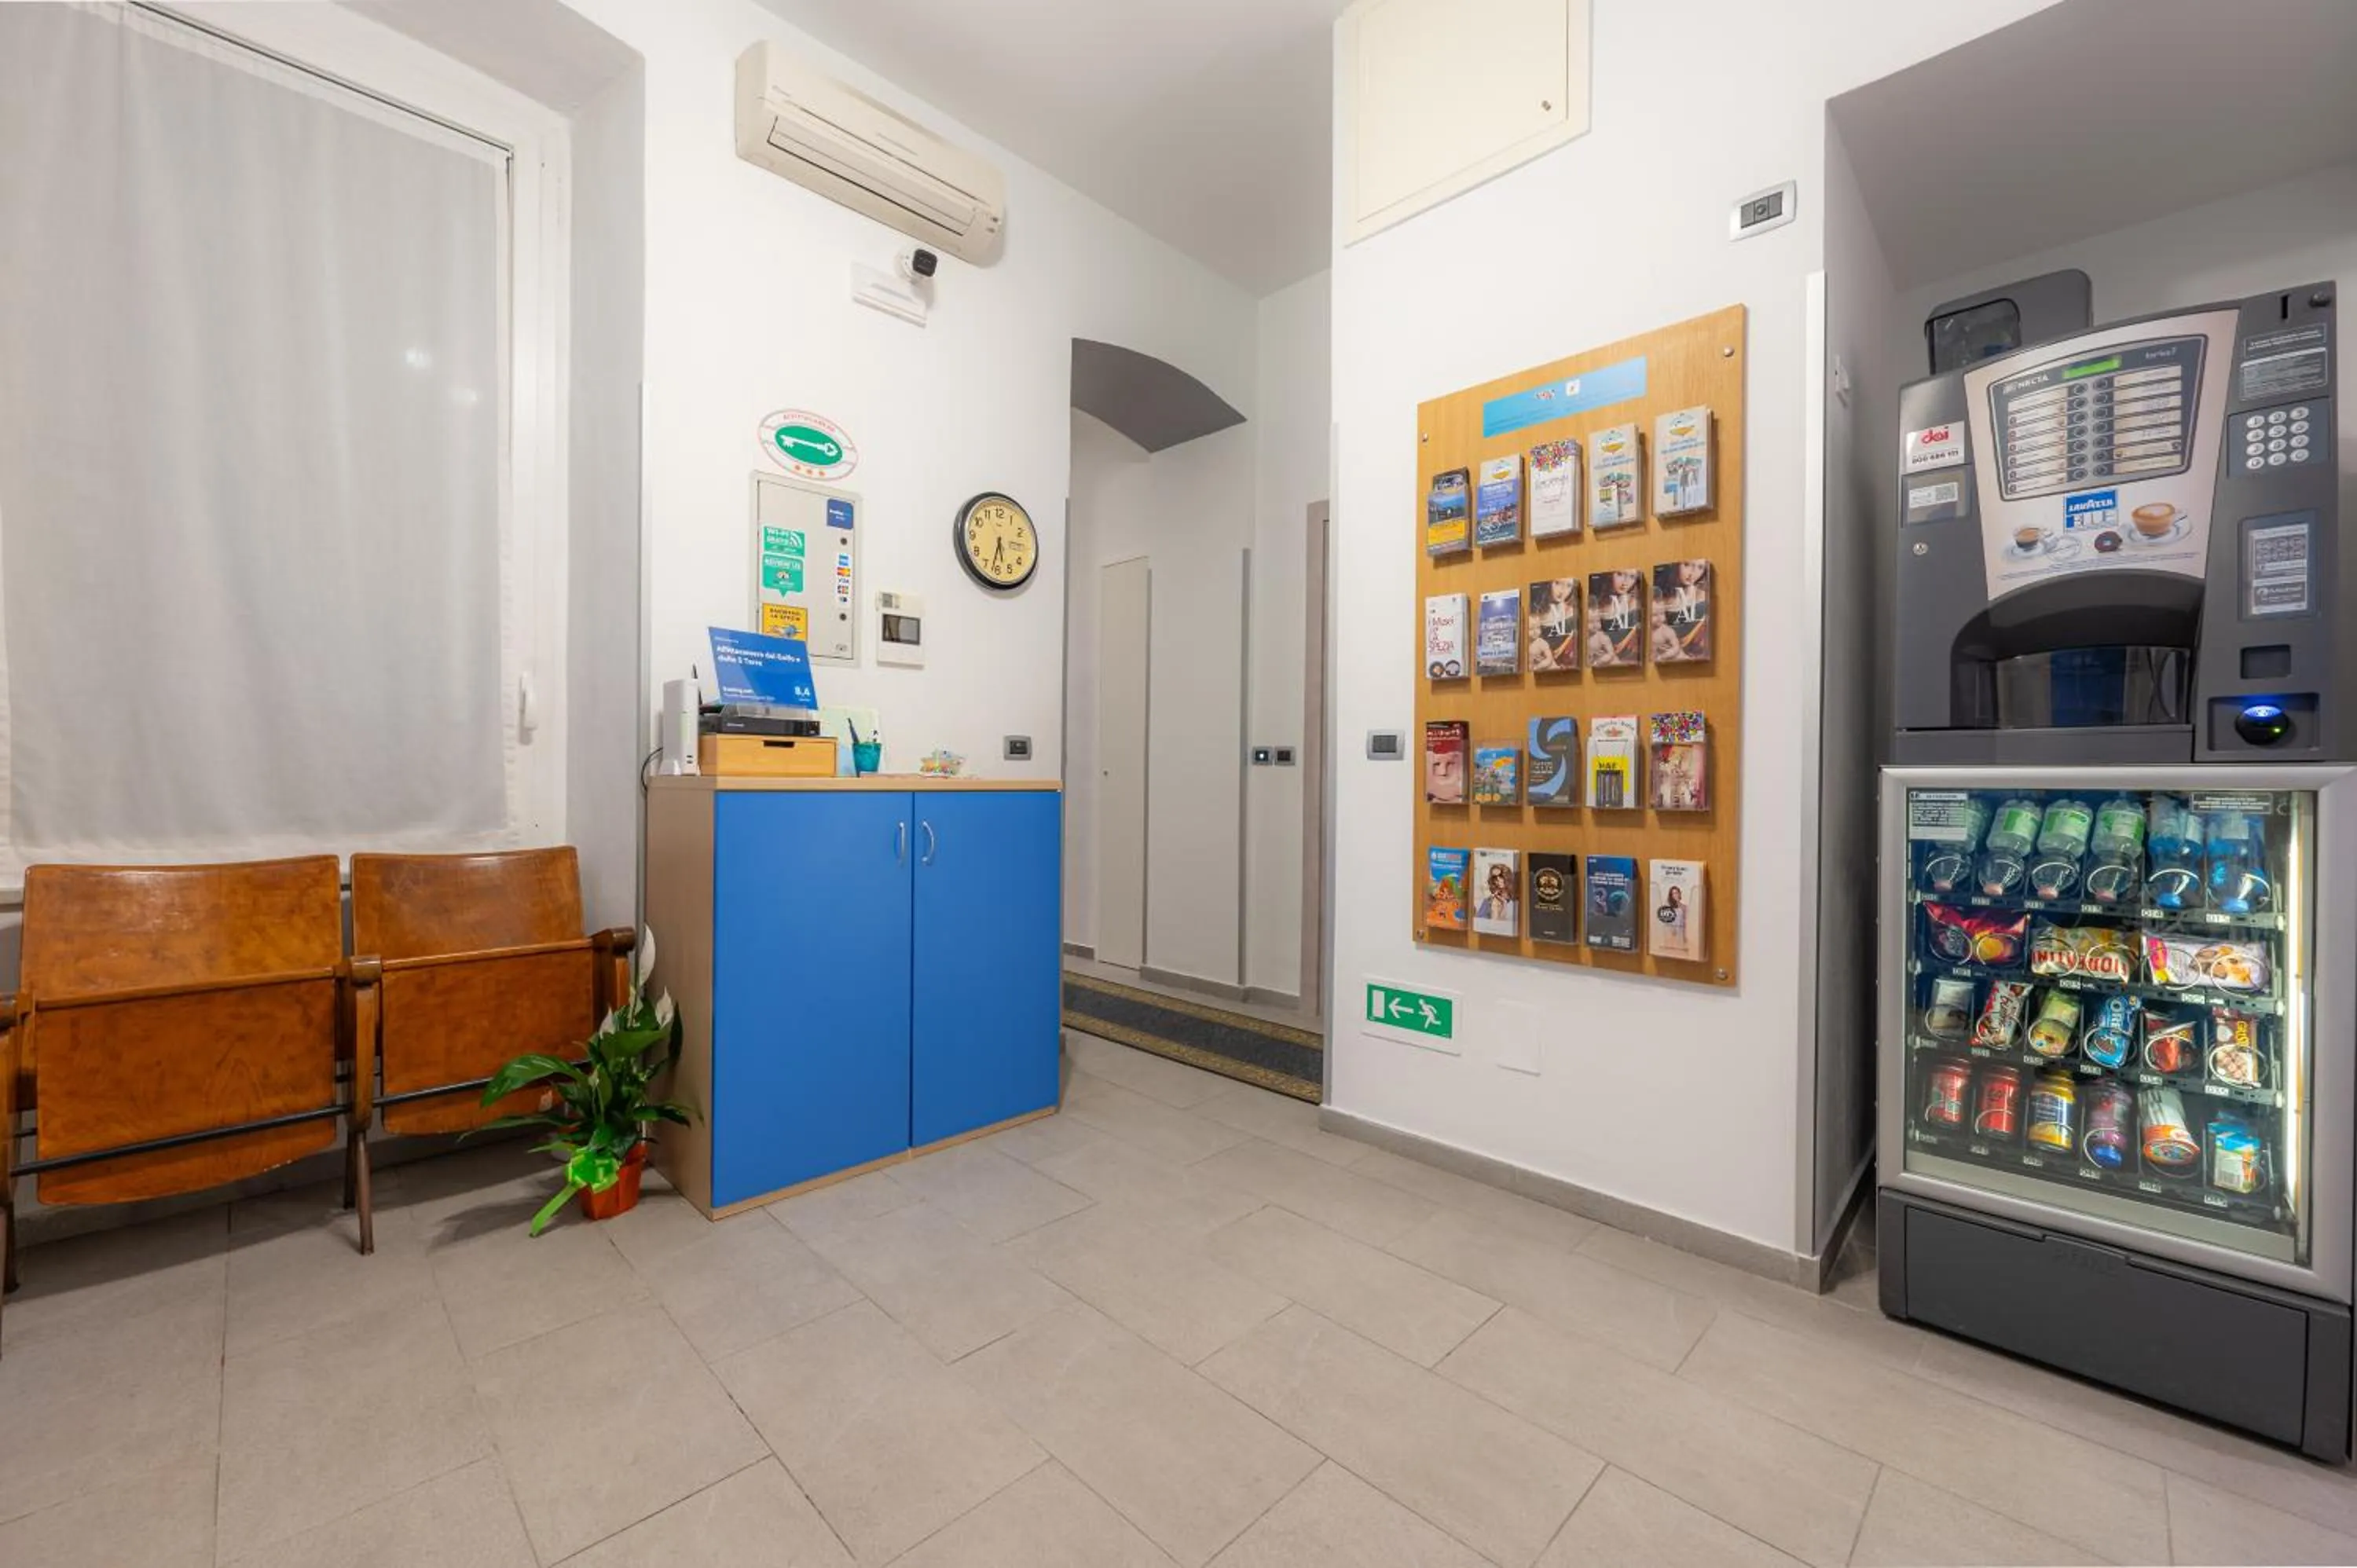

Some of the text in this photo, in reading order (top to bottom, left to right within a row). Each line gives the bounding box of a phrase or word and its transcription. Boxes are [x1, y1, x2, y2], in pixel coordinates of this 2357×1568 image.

[2068, 498, 2113, 512] LAVAZZA
[984, 509, 991, 520] 11
[995, 507, 1005, 518] 12
[975, 517, 984, 528] 10
[1010, 515, 1013, 526] 1
[969, 529, 977, 540] 9
[1017, 527, 1023, 537] 2
[974, 546, 980, 557] 8
[982, 559, 988, 569] 7
[1017, 556, 1022, 566] 4
[995, 565, 1001, 576] 6
[1006, 563, 1013, 574] 5
